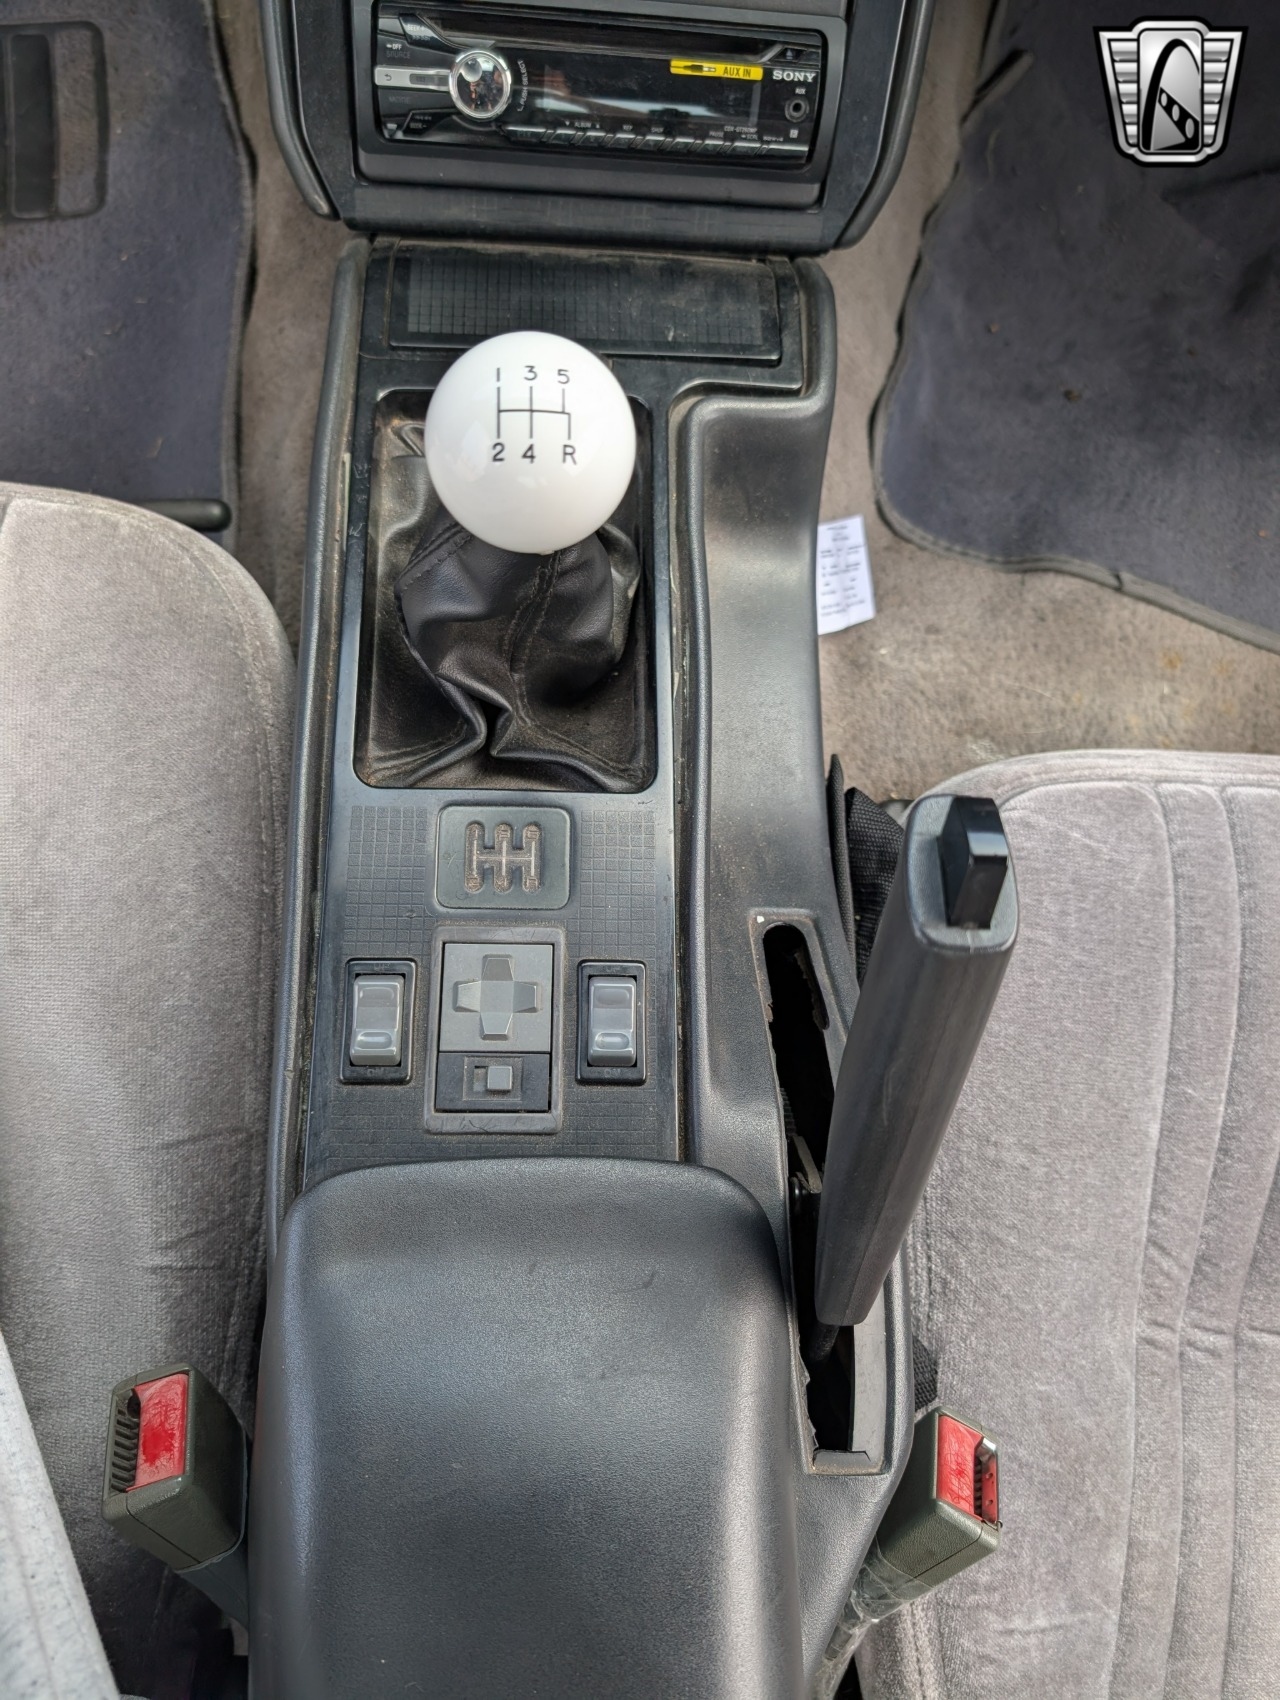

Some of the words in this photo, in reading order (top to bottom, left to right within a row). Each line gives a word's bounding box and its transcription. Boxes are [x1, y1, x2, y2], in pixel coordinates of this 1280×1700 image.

[517, 60, 528, 86] SELECT
[723, 66, 741, 77] AUX
[743, 68, 752, 78] IN
[772, 70, 817, 83] SONY
[523, 365, 538, 381] 3
[557, 368, 570, 385] 5
[492, 442, 505, 463] 2
[521, 443, 536, 464] 4
[562, 444, 577, 466] R
